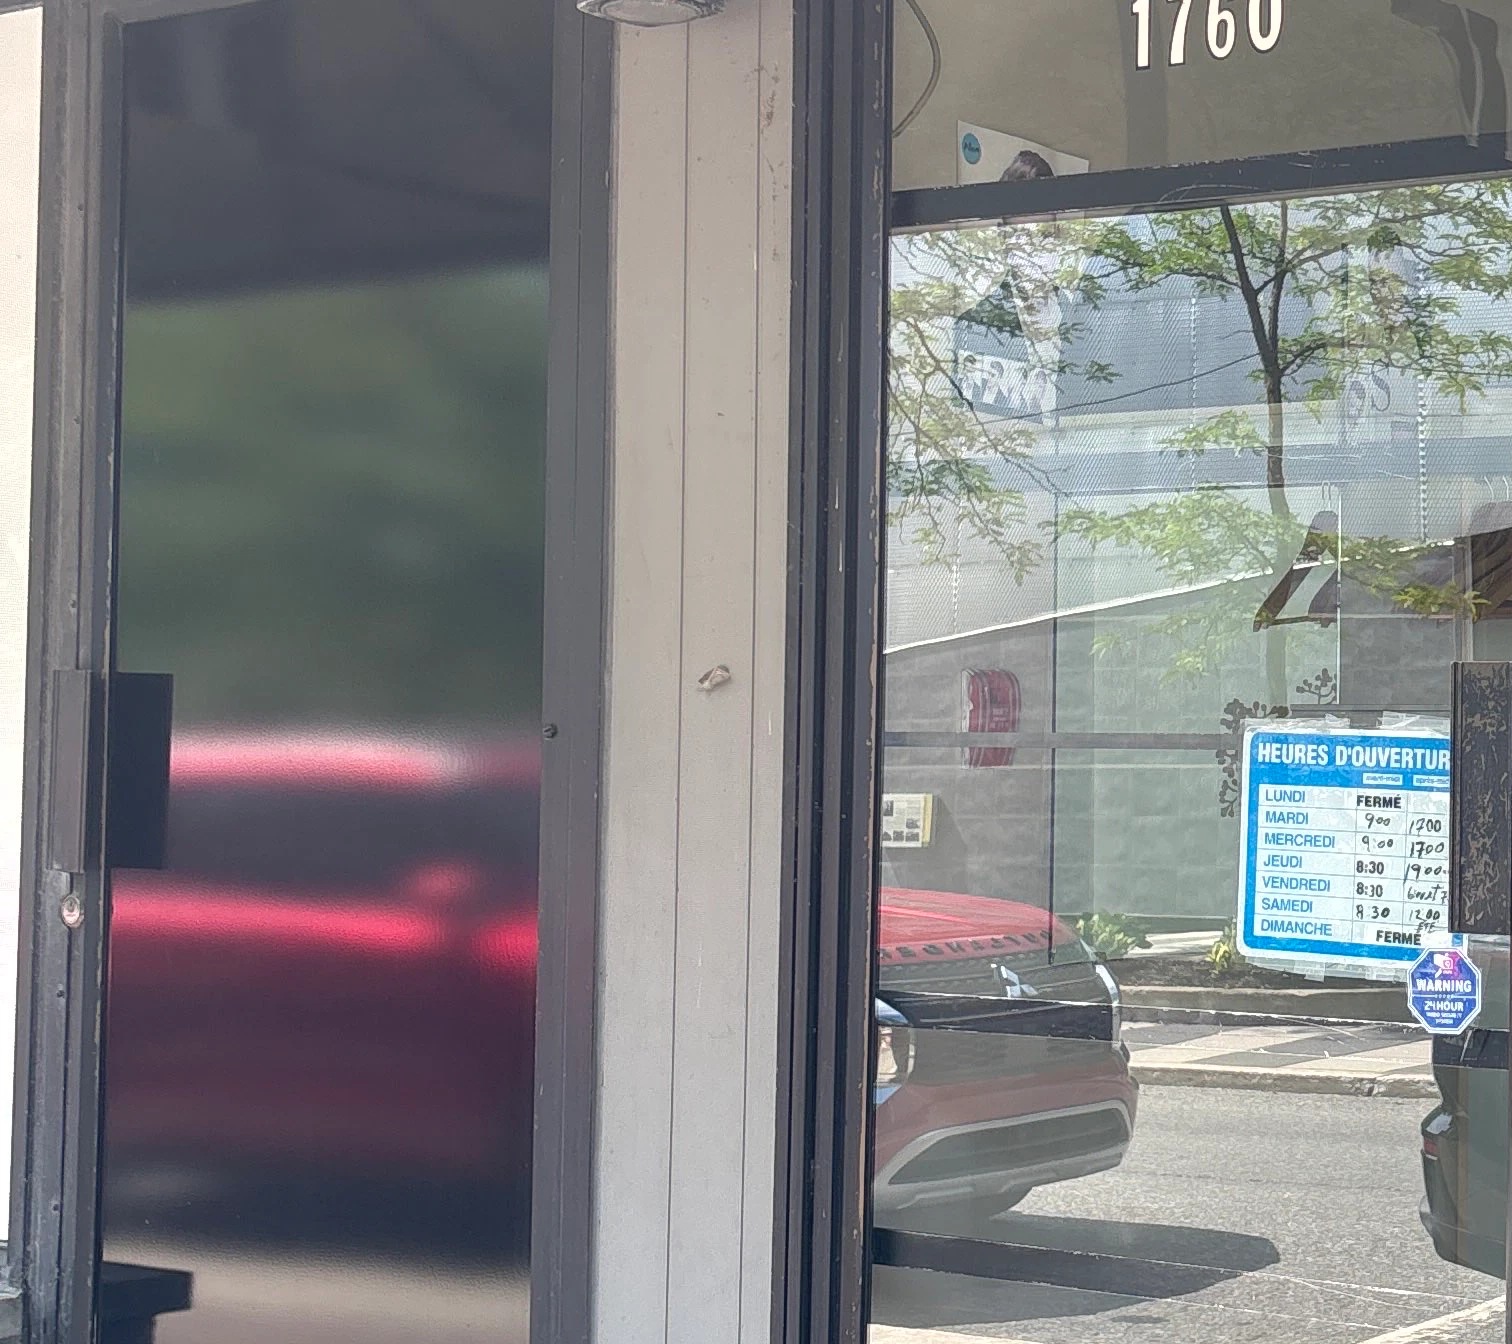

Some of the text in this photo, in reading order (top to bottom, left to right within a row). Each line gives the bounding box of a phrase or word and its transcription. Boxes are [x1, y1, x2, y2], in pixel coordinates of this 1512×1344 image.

[1258, 742, 1450, 771] HEURES D'OUVERTUR
[1265, 789, 1402, 809] LUNDI FERMÉ
[1265, 811, 1309, 825] MARDI
[1264, 832, 1336, 848] MERCREDI
[1263, 854, 1303, 869] JEUDI
[1356, 860, 1385, 875] 8:30
[1262, 876, 1331, 892] VENDREDI
[1356, 882, 1383, 898] 8:30
[1261, 898, 1313, 913] SAMEDI
[1260, 919, 1333, 937] DIMANCHE
[1416, 978, 1472, 993] WARNING
